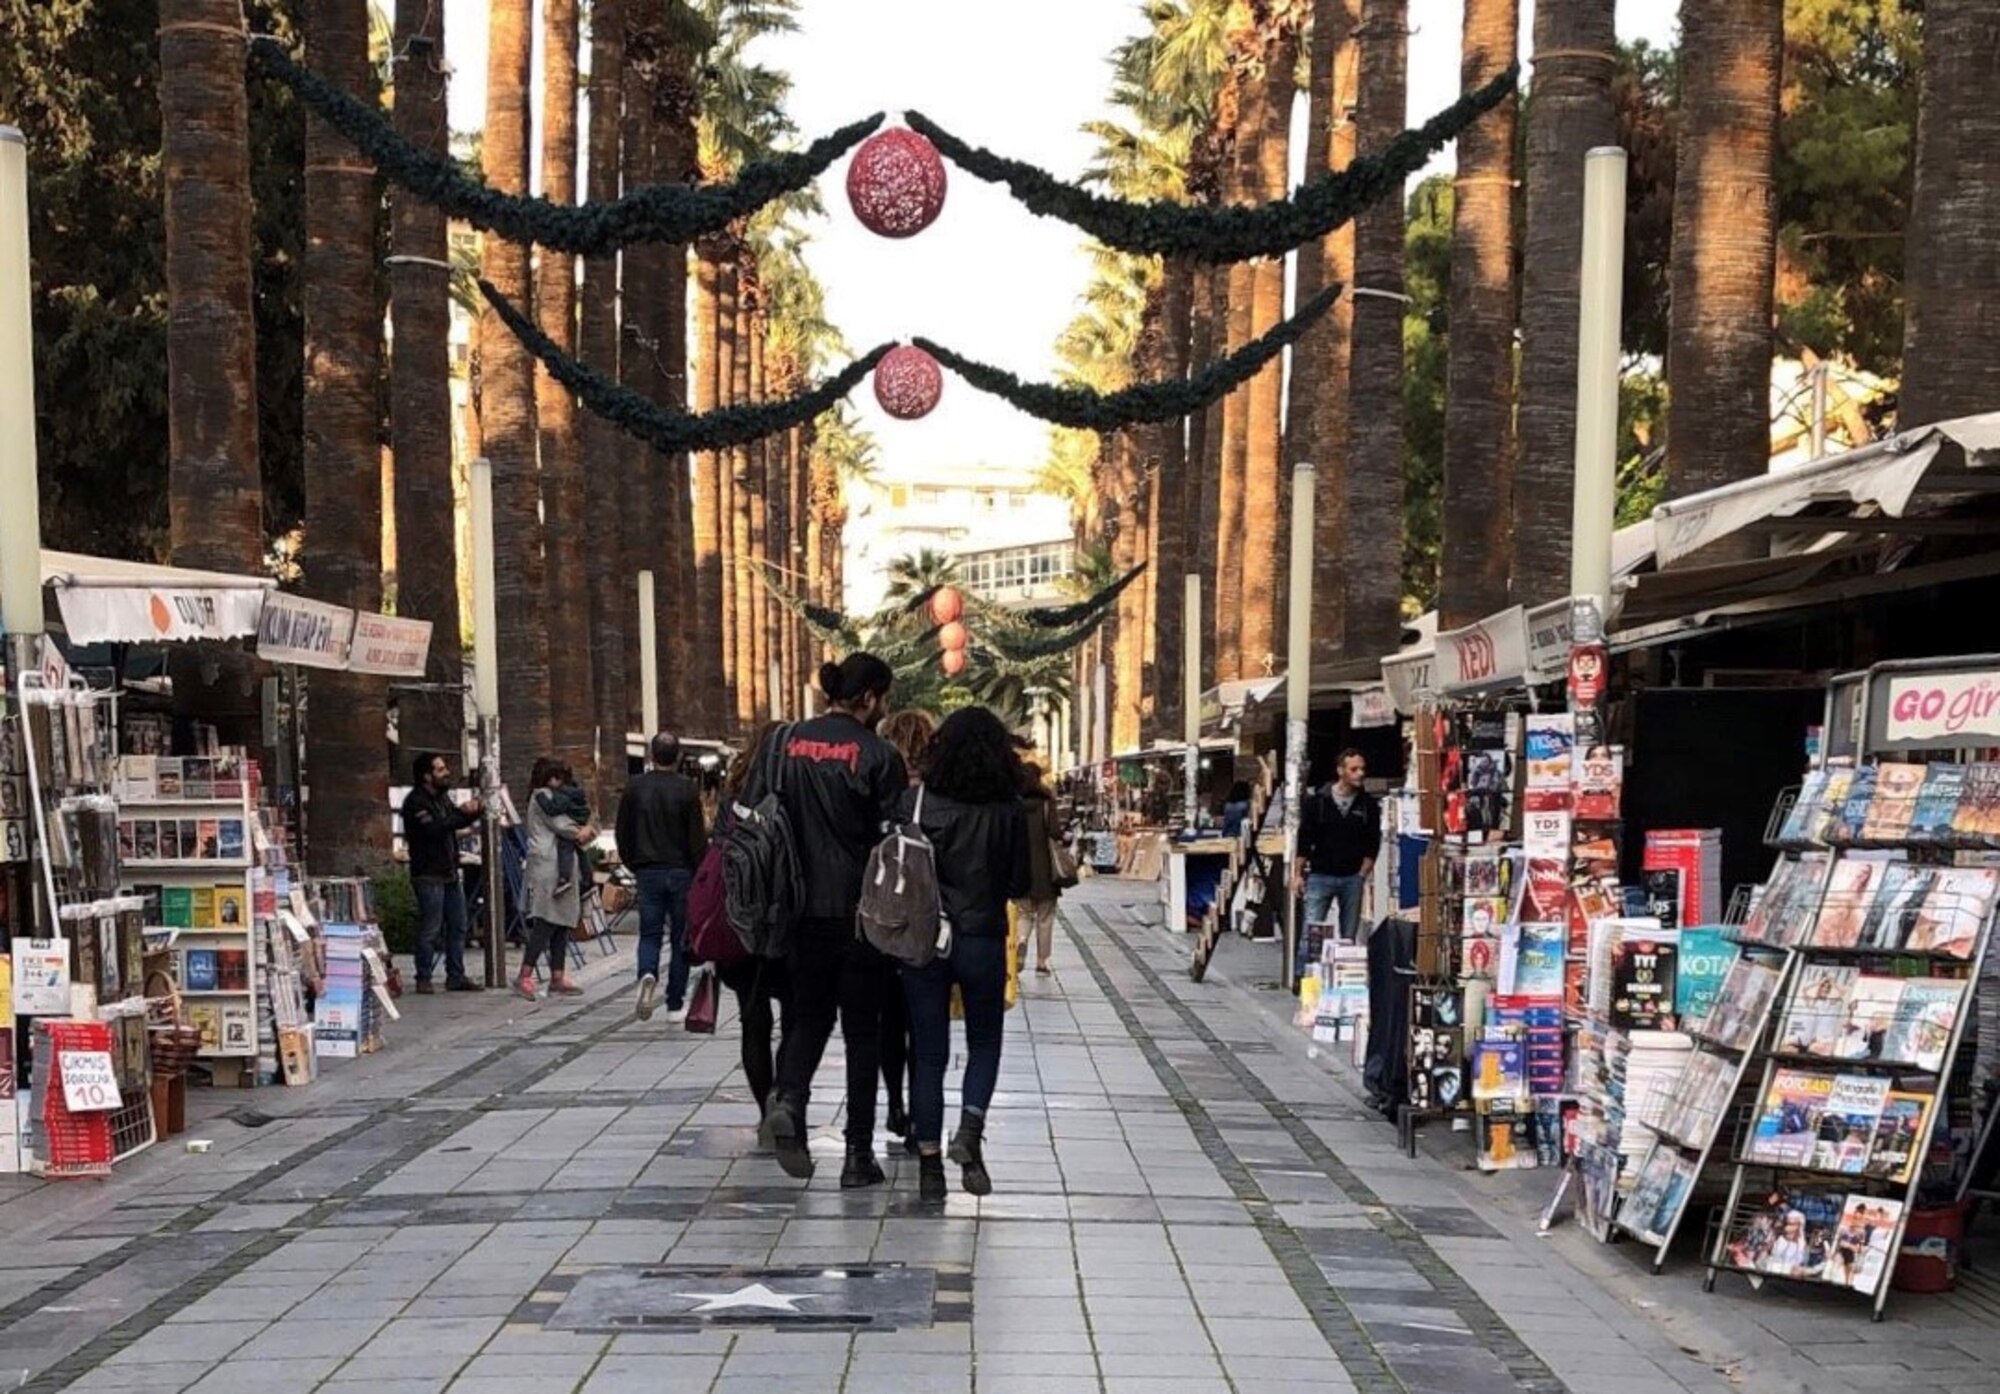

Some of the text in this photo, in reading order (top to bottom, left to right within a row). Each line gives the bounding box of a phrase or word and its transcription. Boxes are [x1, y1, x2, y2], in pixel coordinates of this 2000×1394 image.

[1894, 689, 1945, 722] GO
[1582, 763, 1614, 777] YDS
[1534, 819, 1560, 829] YDS
[1634, 955, 1658, 969] TYT
[76, 1085, 104, 1105] 10
